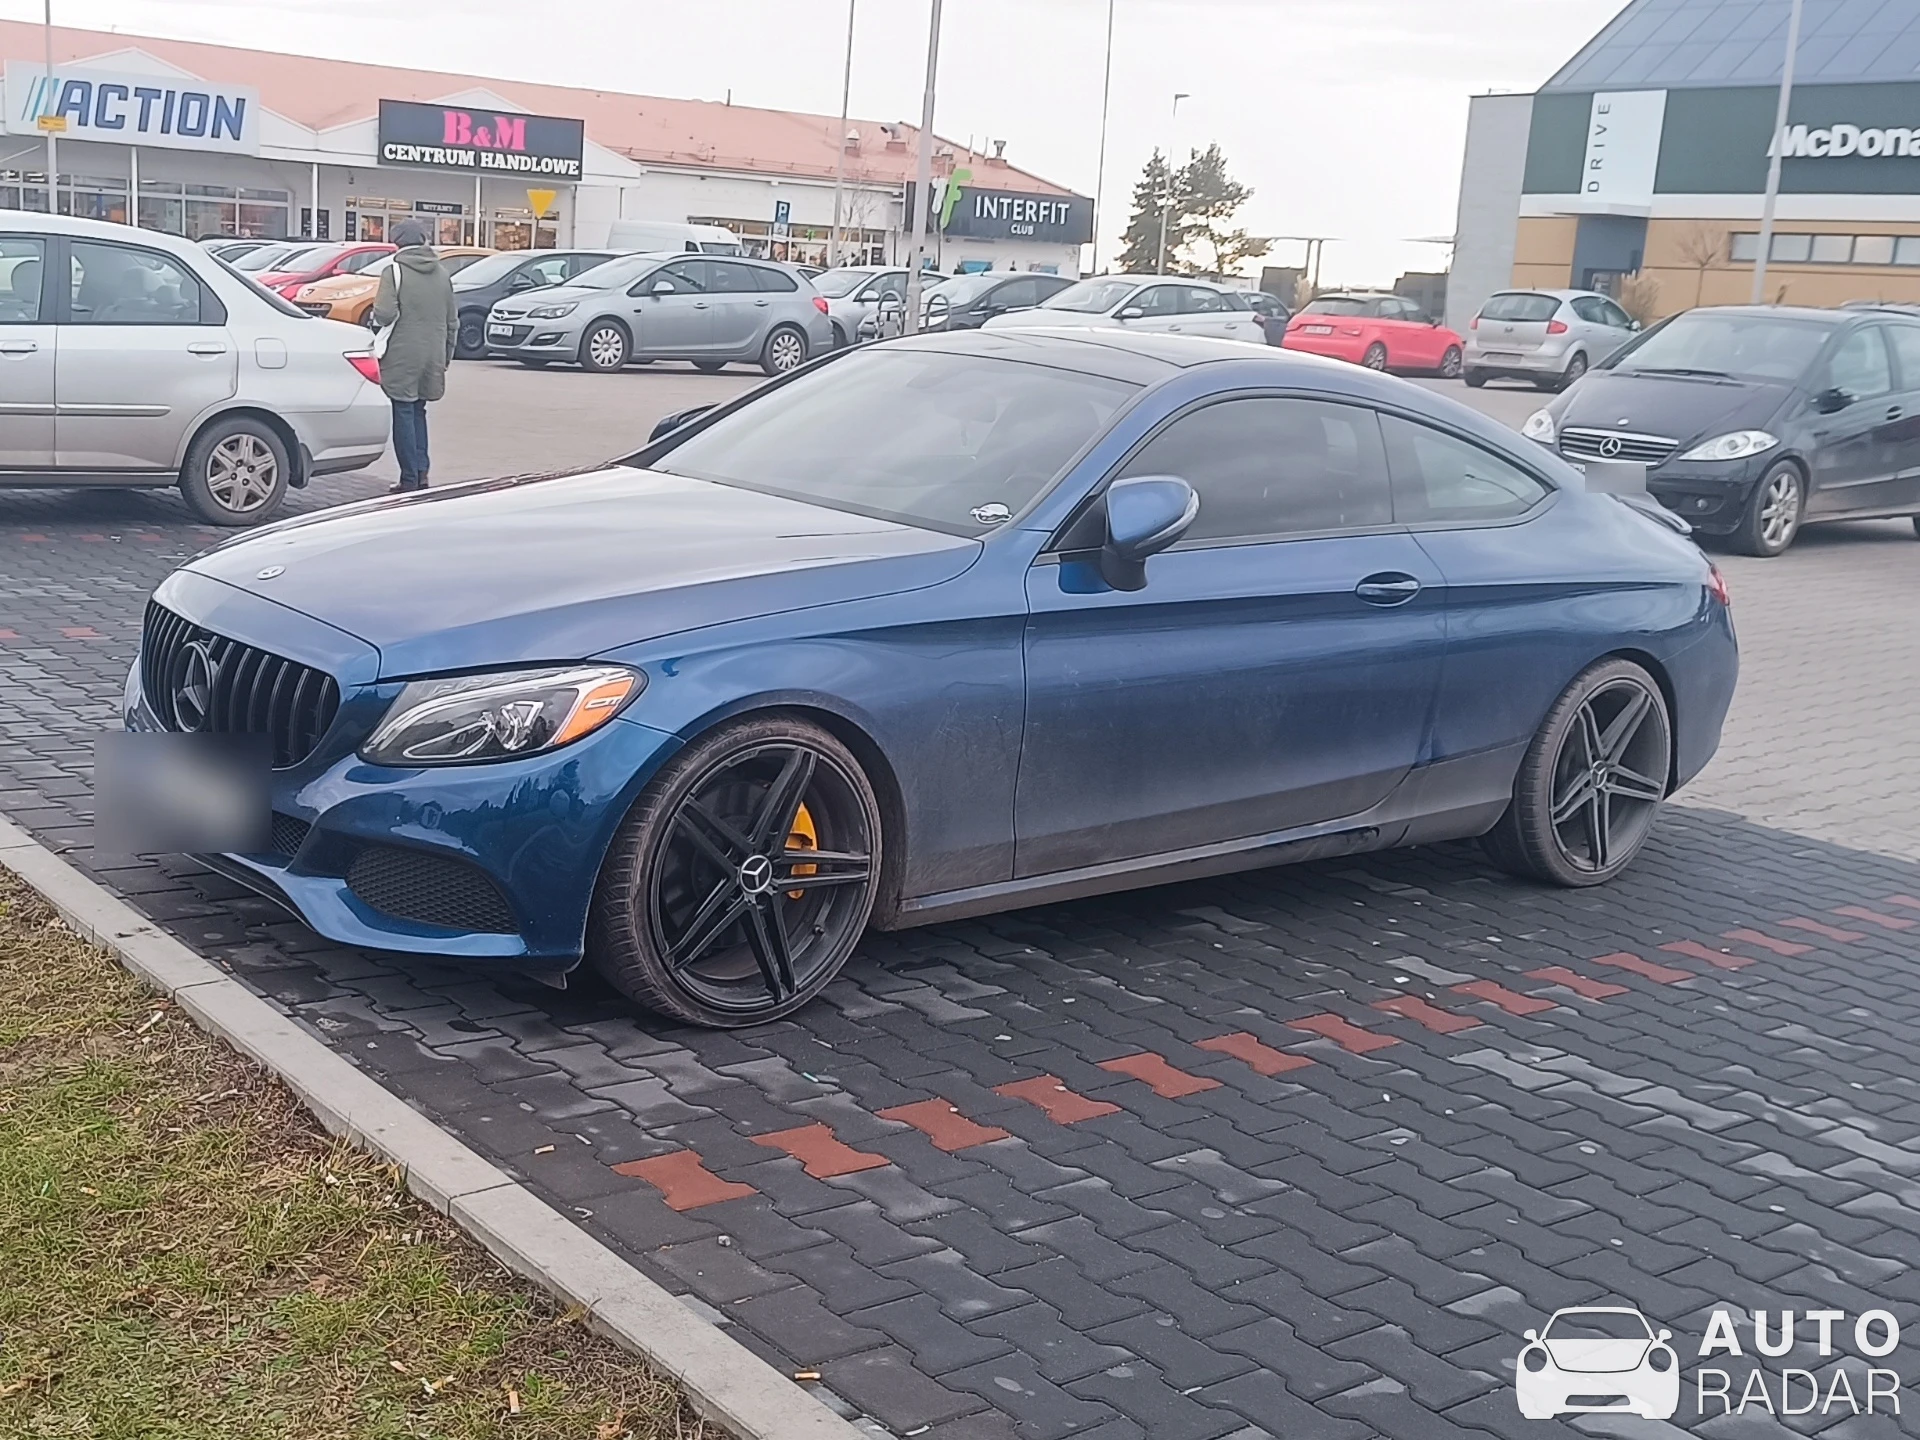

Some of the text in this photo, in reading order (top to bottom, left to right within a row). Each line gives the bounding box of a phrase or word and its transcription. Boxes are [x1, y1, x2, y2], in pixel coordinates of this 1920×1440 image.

[56, 80, 246, 141] ACTION
[442, 110, 526, 151] B&M
[1587, 103, 1611, 193] DRIVE
[383, 143, 579, 176] CENTRUM HANDLOWE
[974, 195, 1070, 225] INTERFIT
[1010, 223, 1034, 236] CLUB
